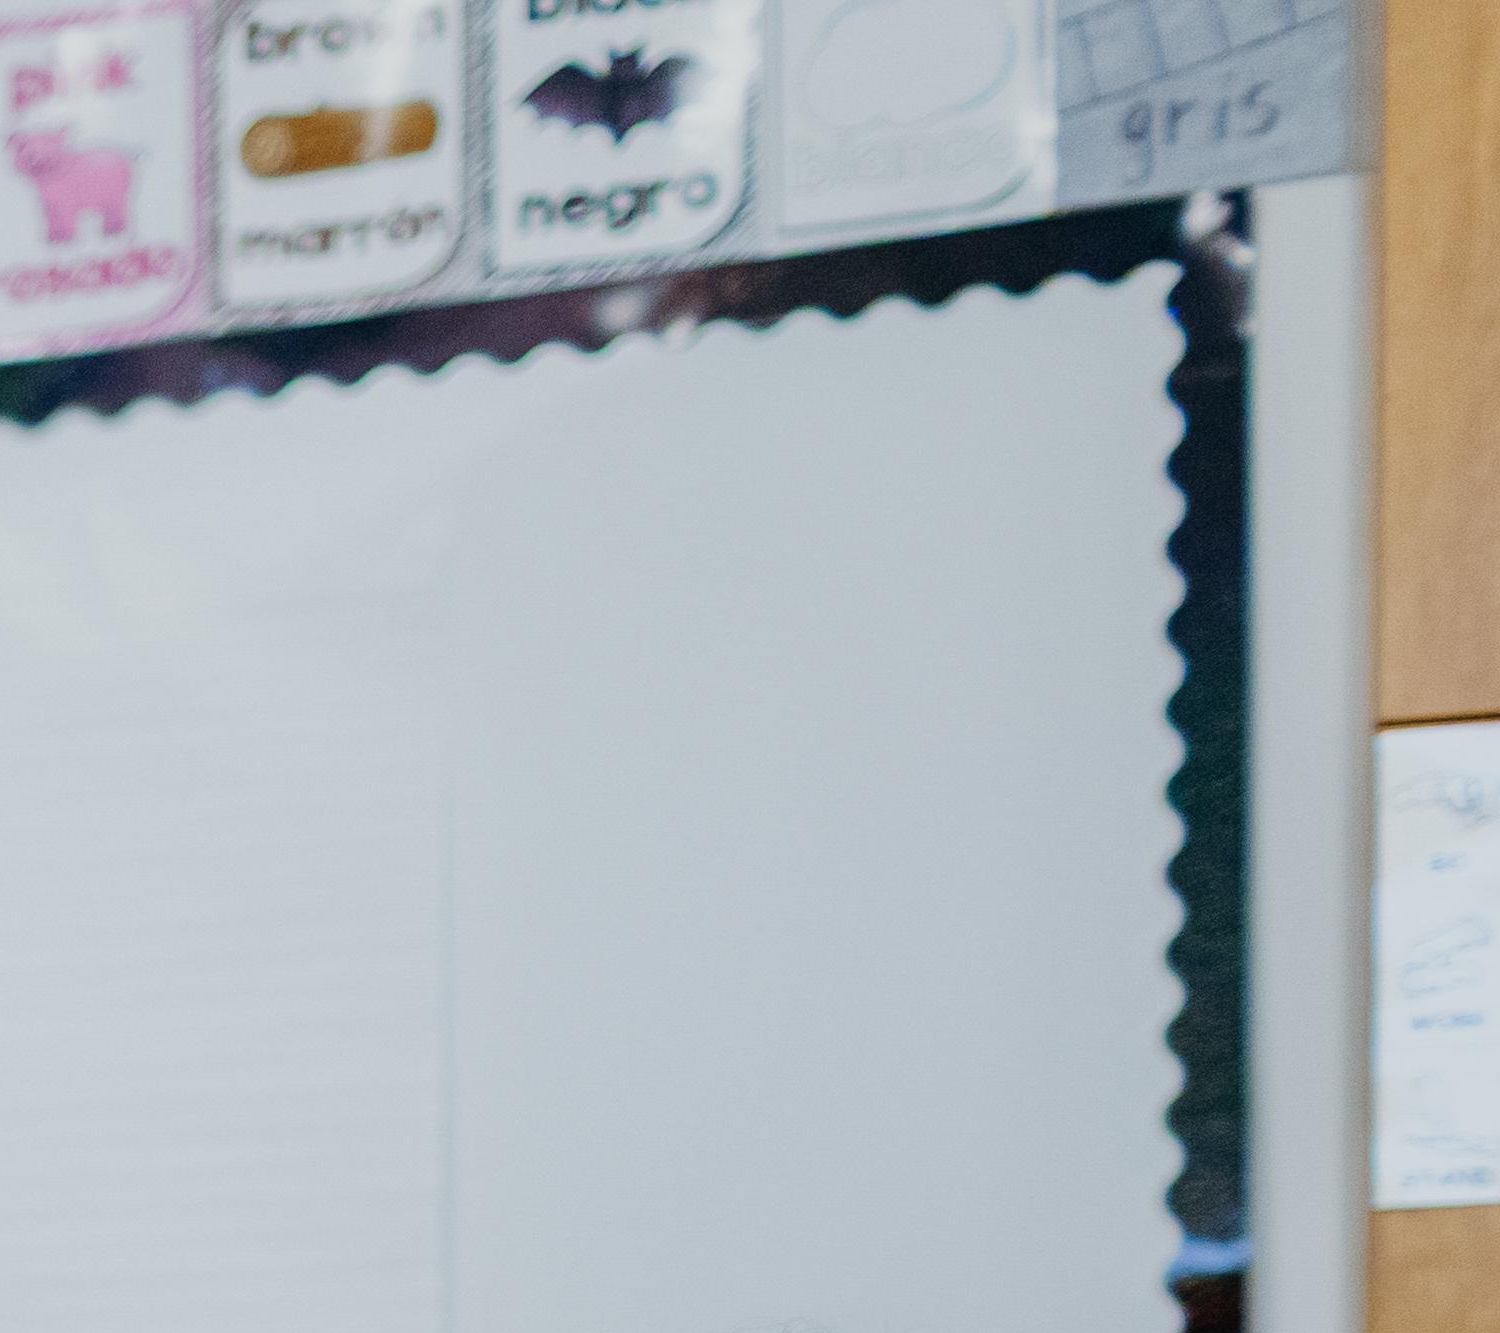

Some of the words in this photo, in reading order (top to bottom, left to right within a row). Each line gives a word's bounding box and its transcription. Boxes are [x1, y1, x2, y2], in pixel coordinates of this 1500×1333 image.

[246, 6, 446, 62] bron
[10, 50, 134, 109] pk
[1119, 79, 1280, 187] gris
[519, 173, 718, 230] negro
